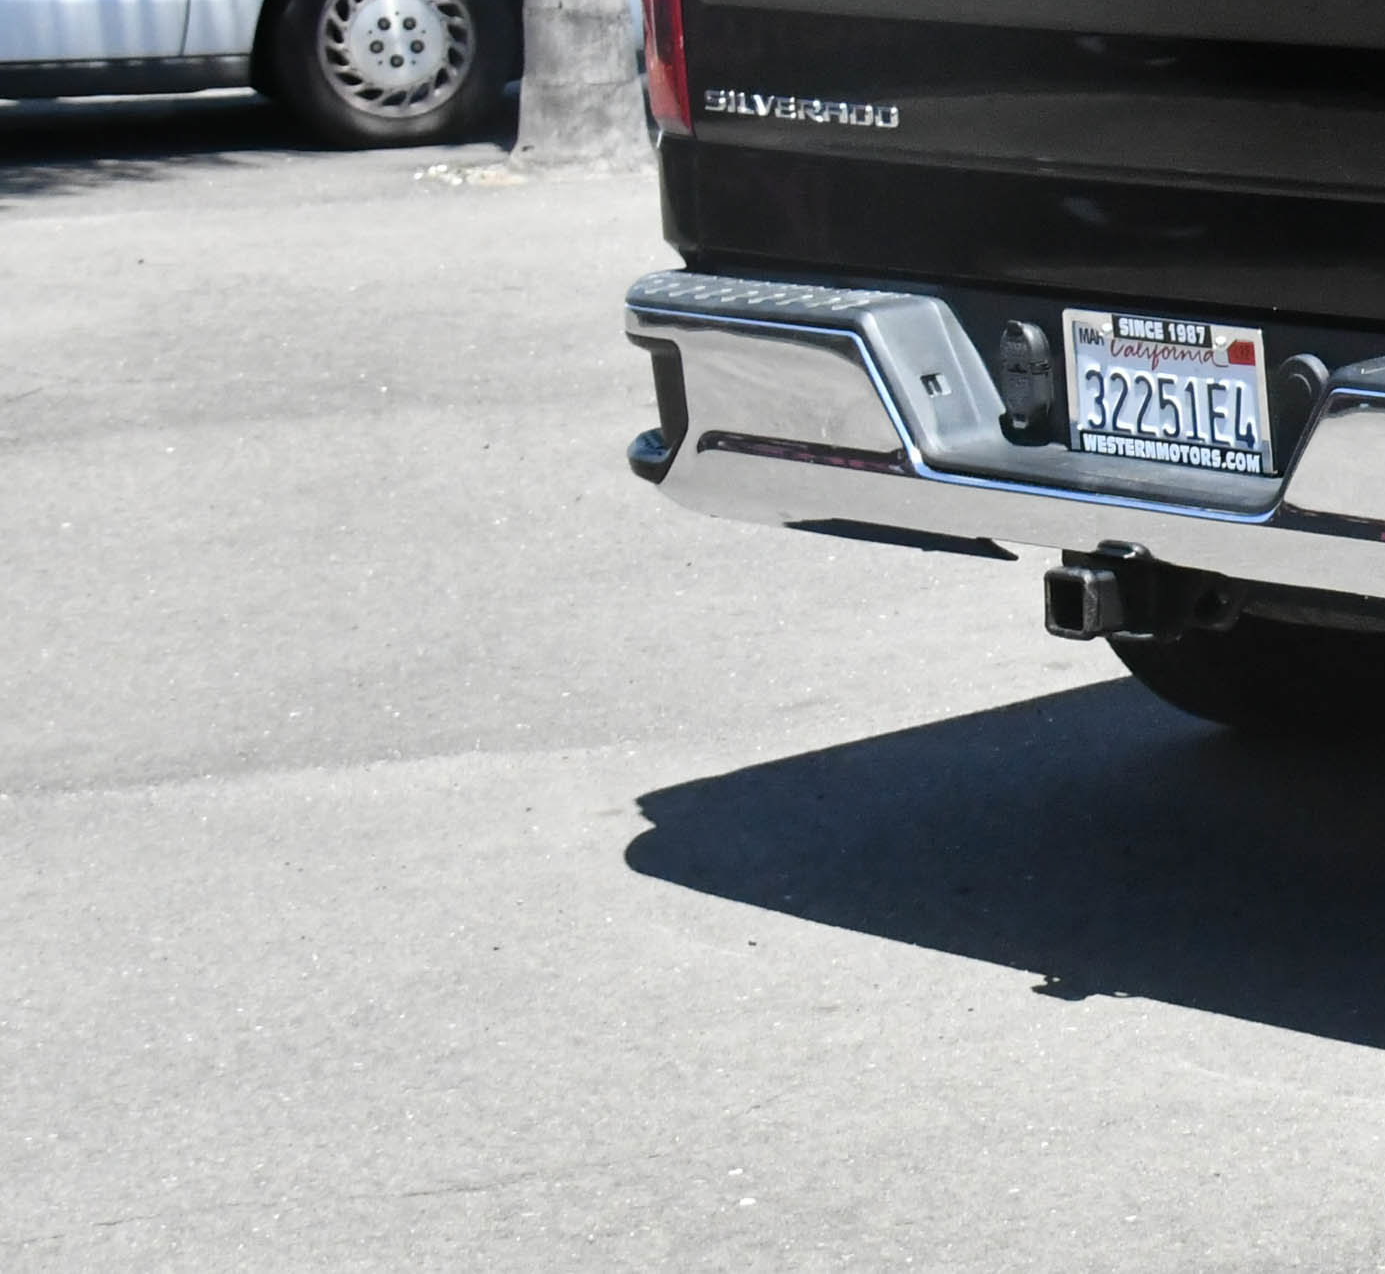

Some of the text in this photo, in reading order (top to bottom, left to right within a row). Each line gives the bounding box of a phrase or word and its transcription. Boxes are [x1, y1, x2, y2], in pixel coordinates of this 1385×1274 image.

[704, 89, 900, 128] SILVERADO
[1117, 317, 1206, 345] SINCE 1987
[1085, 369, 1257, 450] 32251E4
[1083, 434, 1262, 474] WESTERNMOTORS.COM
